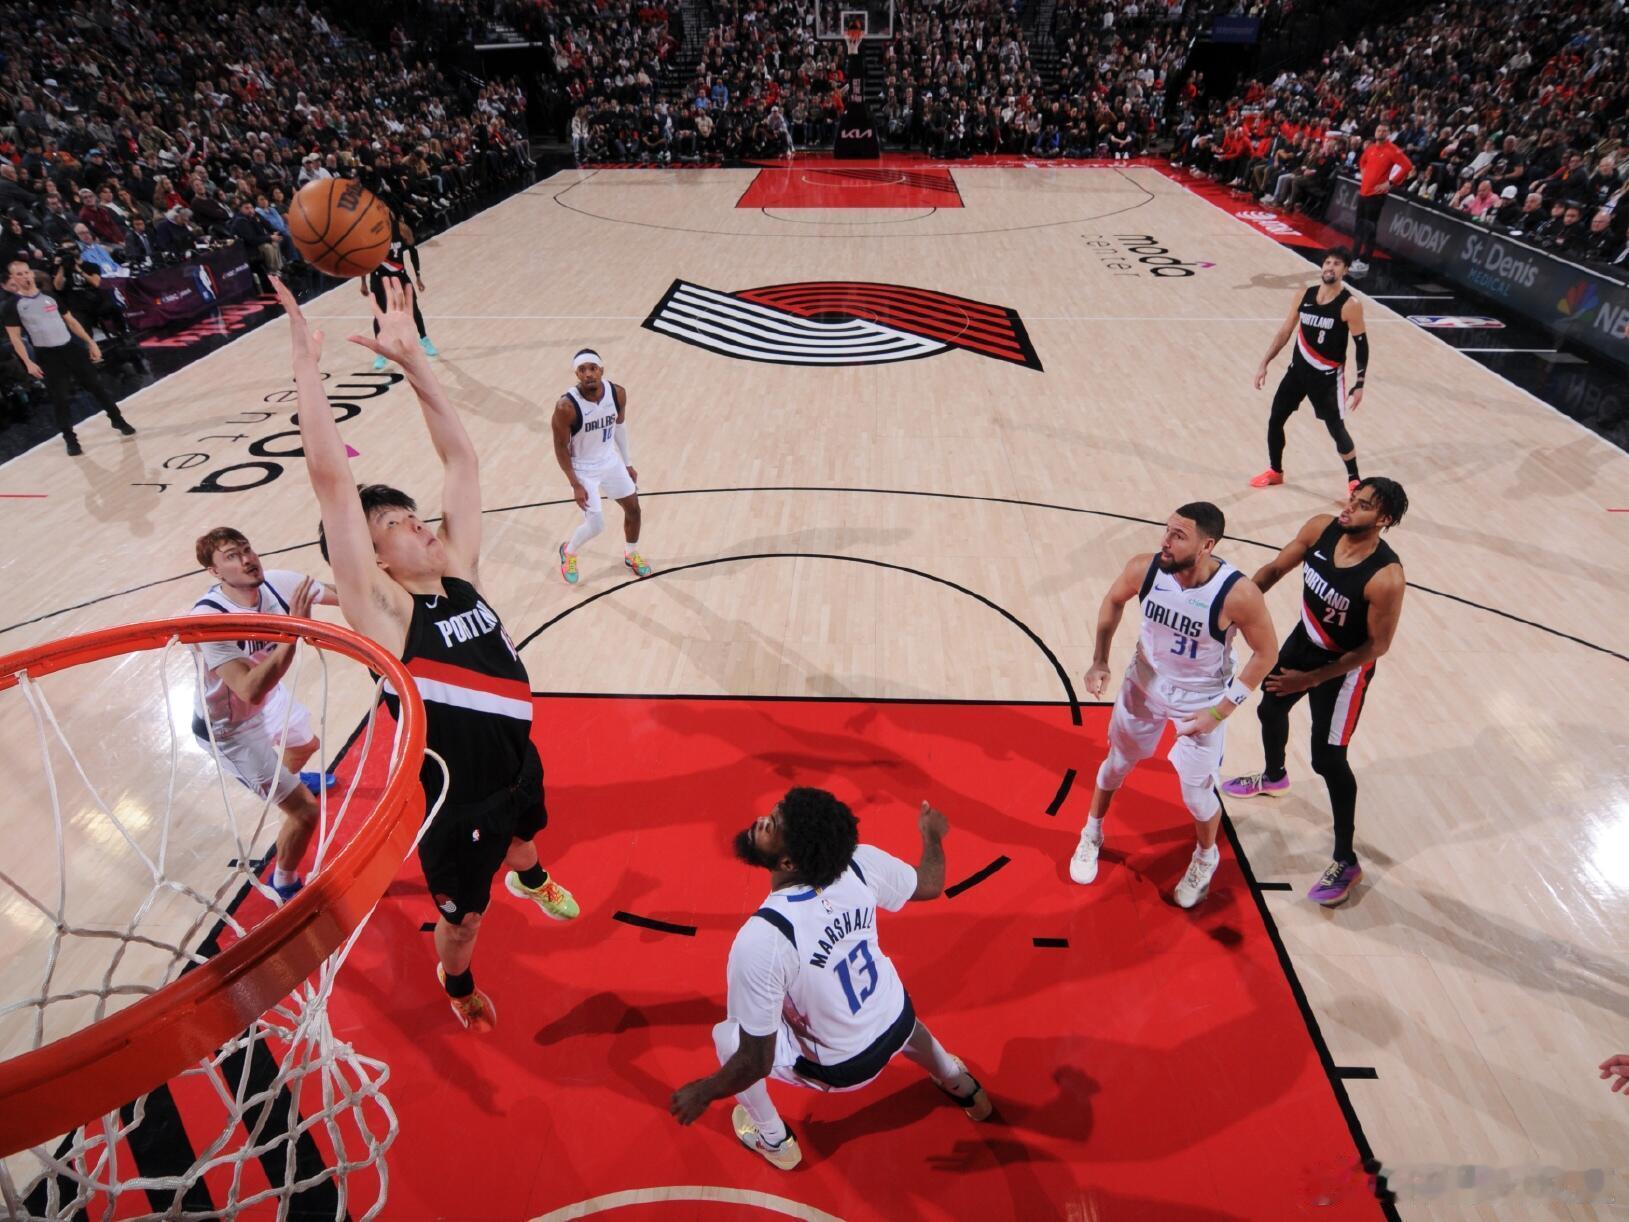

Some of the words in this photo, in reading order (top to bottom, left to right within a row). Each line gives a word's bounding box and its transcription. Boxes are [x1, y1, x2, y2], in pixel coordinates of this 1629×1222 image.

[841, 128, 873, 138] KIA
[1389, 213, 1451, 254] MONDAY
[1112, 234, 1198, 277] moda
[1461, 234, 1484, 265] St.
[1485, 243, 1539, 287] Denis
[1300, 311, 1335, 330] PORTLAND
[1317, 329, 1326, 345] 8
[584, 413, 616, 433] DALLAS
[1303, 560, 1351, 611] PORTLAND
[1144, 599, 1203, 638] DALLAS
[1322, 607, 1347, 627] 21
[1170, 632, 1199, 660] 31
[809, 907, 875, 969] MARSHALL
[833, 939, 878, 1016] 13
